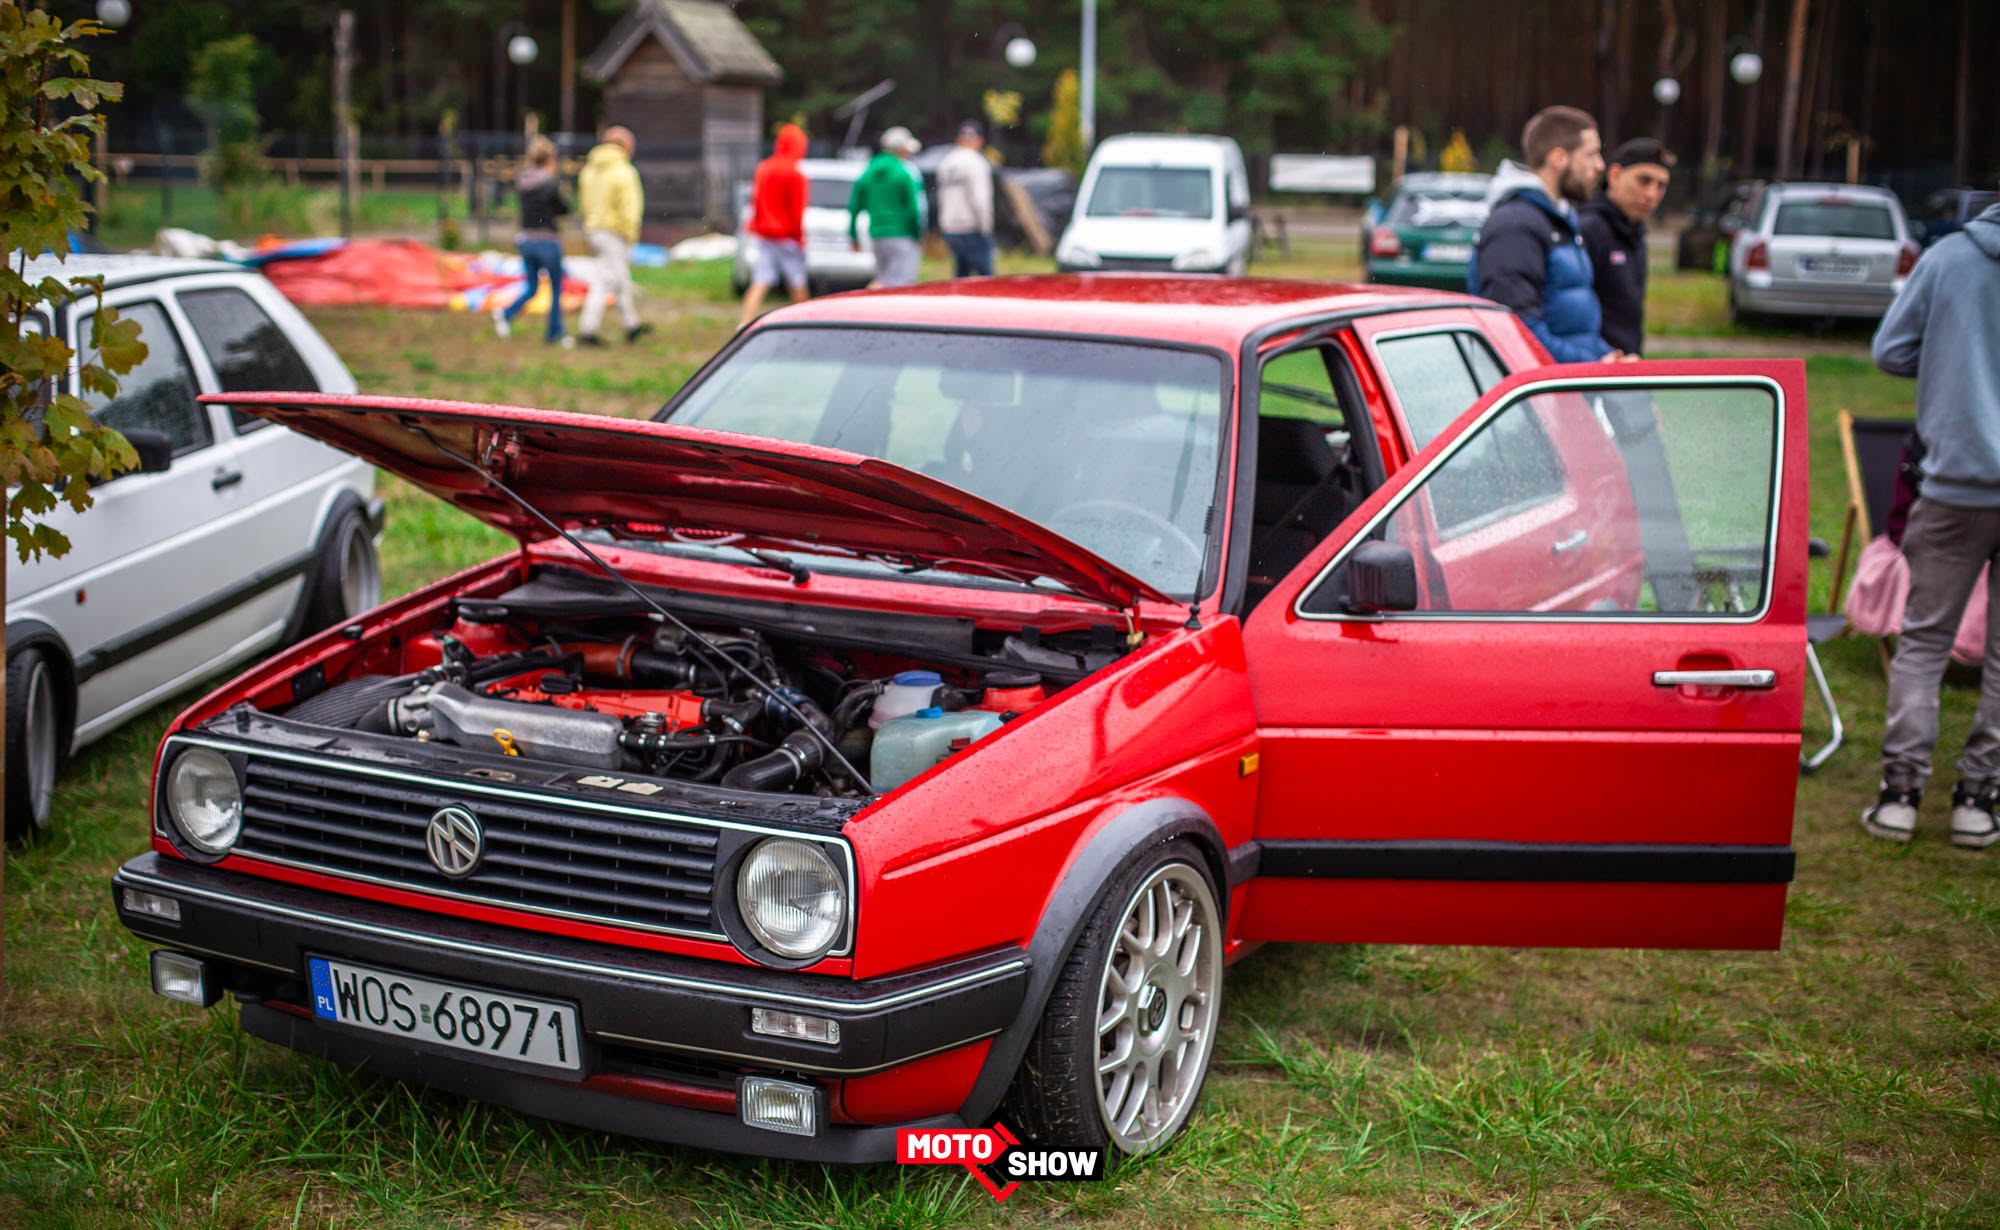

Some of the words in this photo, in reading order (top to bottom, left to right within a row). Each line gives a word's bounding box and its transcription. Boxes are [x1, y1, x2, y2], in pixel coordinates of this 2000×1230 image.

[317, 995, 334, 1012] PL
[333, 968, 417, 1033] WOS
[433, 991, 567, 1063] 68971
